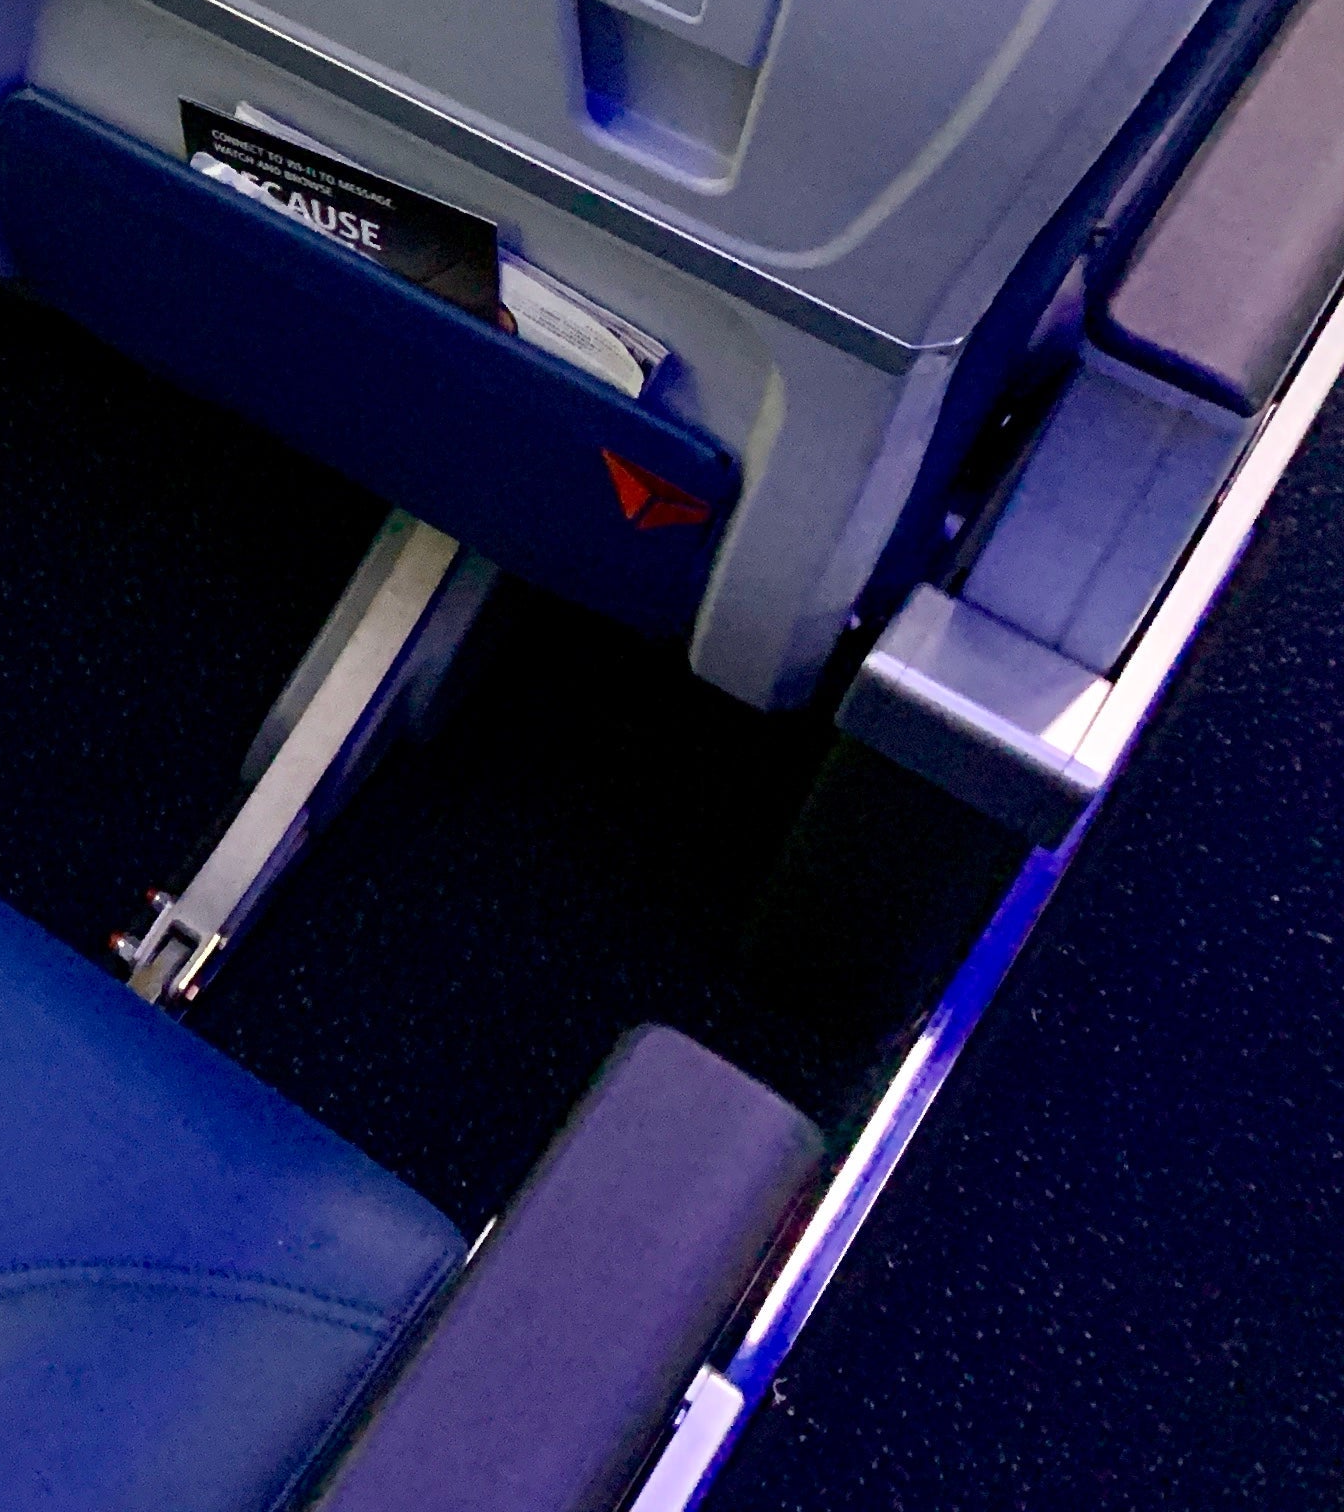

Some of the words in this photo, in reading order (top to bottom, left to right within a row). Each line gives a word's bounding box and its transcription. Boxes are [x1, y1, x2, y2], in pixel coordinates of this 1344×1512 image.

[211, 129, 264, 157] CONNECT
[267, 150, 284, 165] TO
[319, 171, 336, 185] TO
[214, 143, 255, 165] WATCH
[256, 159, 283, 177] AND
[283, 169, 334, 199] BROWSE
[239, 170, 383, 252] CAUSE
